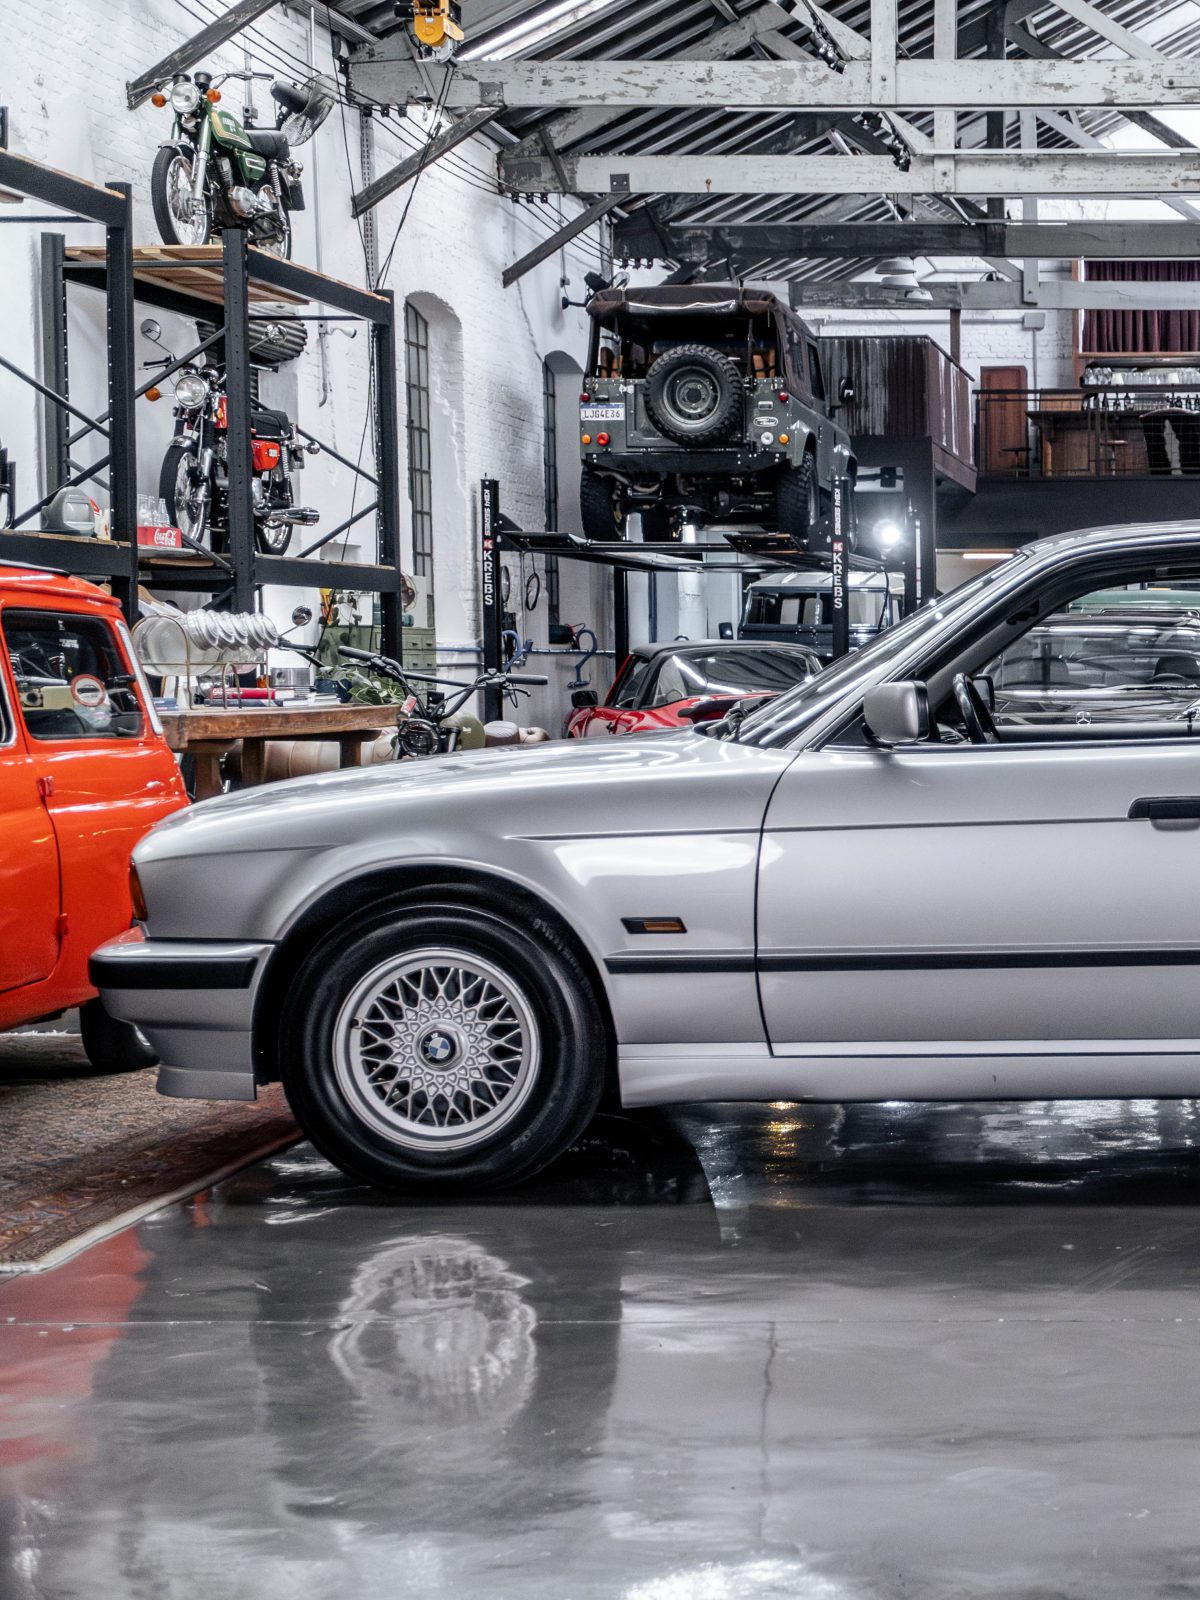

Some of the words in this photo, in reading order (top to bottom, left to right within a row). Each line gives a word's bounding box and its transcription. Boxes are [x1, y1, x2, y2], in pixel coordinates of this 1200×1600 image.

[584, 409, 620, 419] LJG4E36
[483, 489, 491, 507] KB4
[483, 550, 493, 606] KREBS
[833, 552, 843, 609] KREBS
